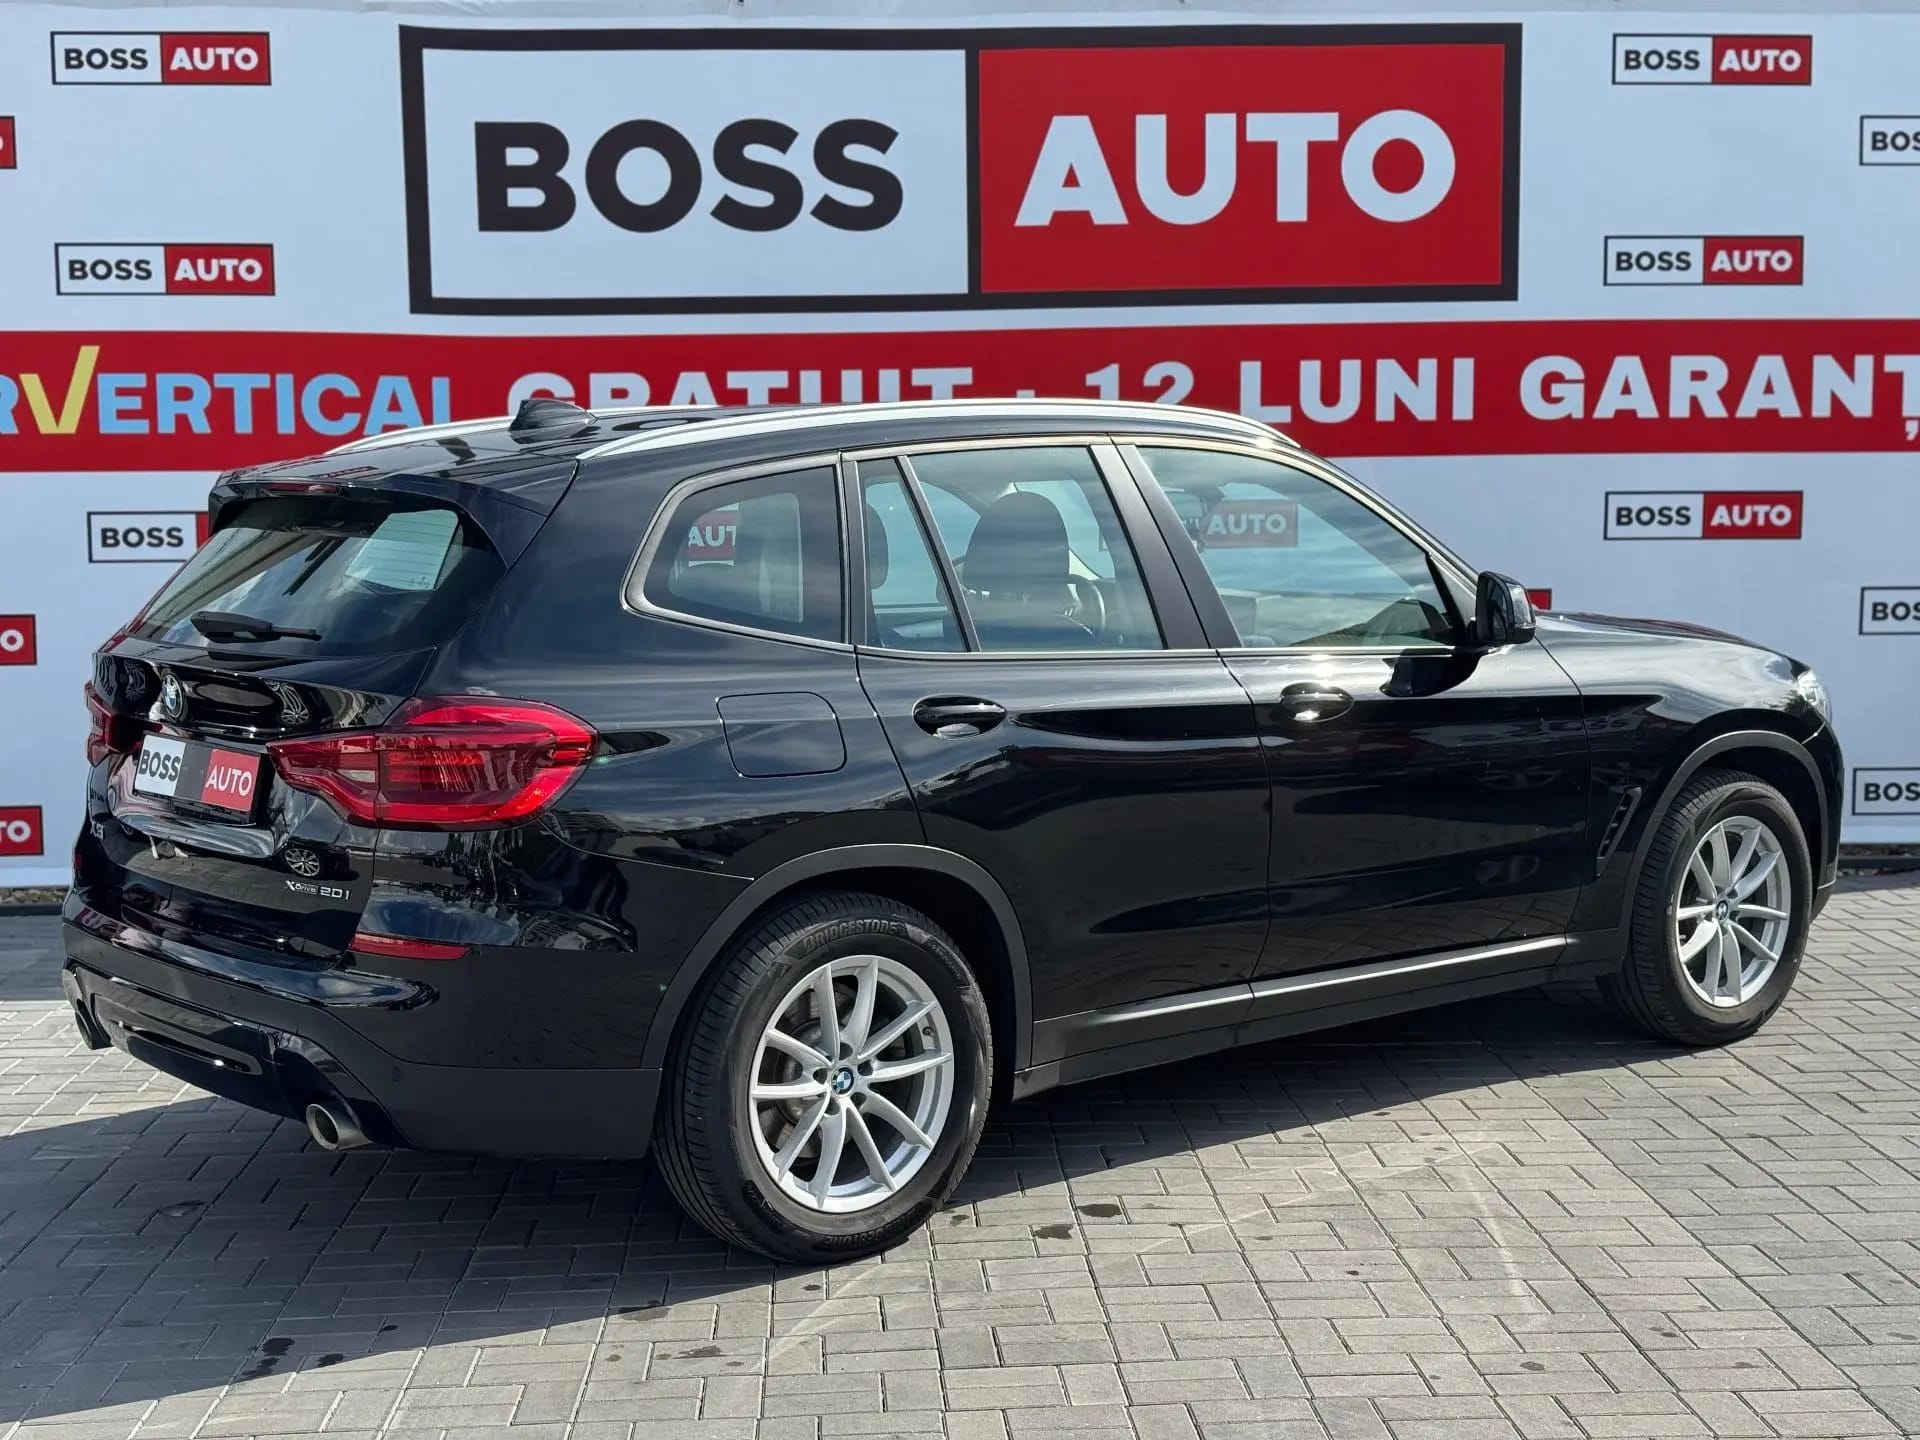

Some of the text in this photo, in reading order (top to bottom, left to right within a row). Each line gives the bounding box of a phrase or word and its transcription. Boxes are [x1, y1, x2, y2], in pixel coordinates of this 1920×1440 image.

[64, 47, 258, 71] BOSS AUTO
[1624, 49, 1801, 72] BOSS AUTO
[474, 109, 1456, 233] BOSS AUTO
[68, 257, 262, 281] BOSS AUTO
[1615, 250, 1792, 272] BOSS AUTO
[1086, 361, 1194, 406] 12
[1239, 358, 1475, 423] LUNI
[1207, 513, 1287, 535] AUTO
[1615, 505, 1792, 526] BOSS AUTO
[100, 527, 184, 548] BOSS
[139, 749, 253, 797] BOSS AUTO
